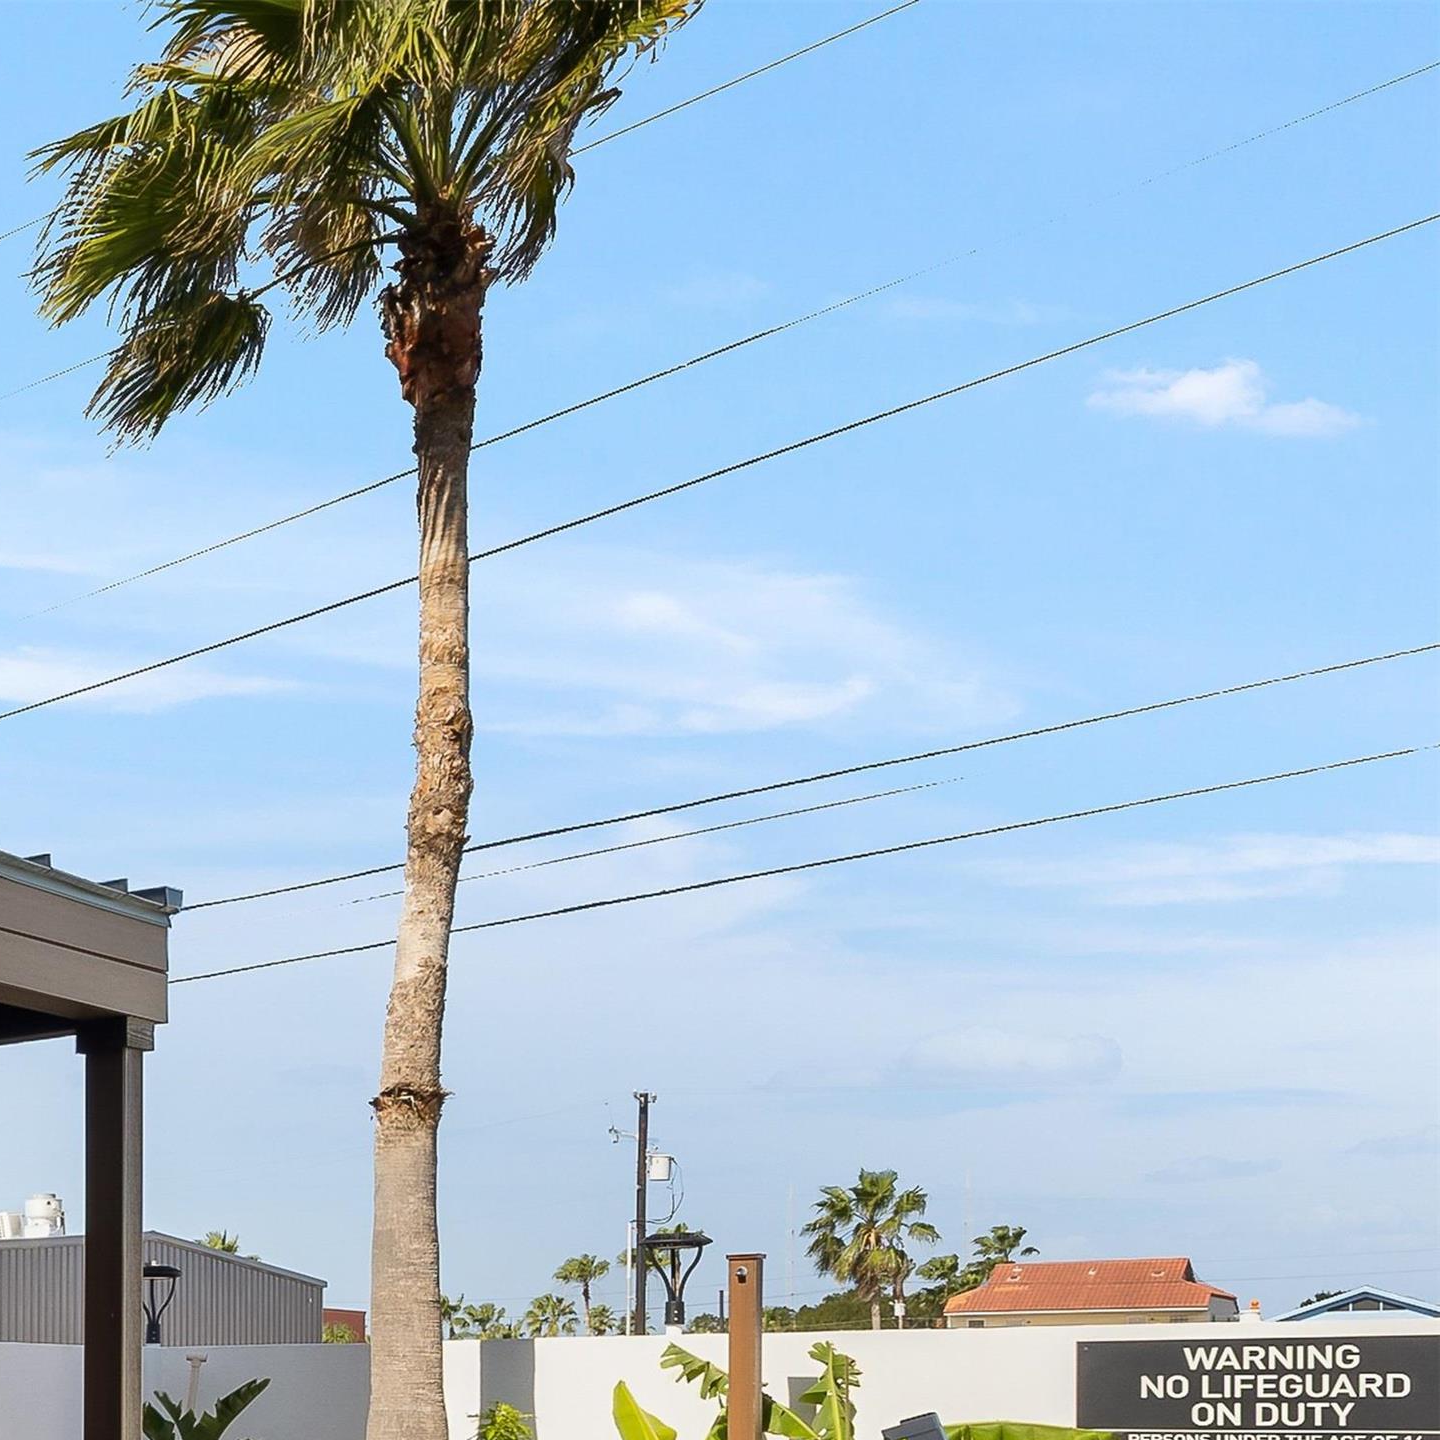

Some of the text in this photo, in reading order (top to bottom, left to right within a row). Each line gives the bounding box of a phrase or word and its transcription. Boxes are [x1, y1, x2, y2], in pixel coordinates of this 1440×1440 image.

[1183, 1345, 1360, 1370] WARNING
[1141, 1374, 1410, 1398] NO LIFEGUARD
[1192, 1403, 1354, 1426] ON DUTY
